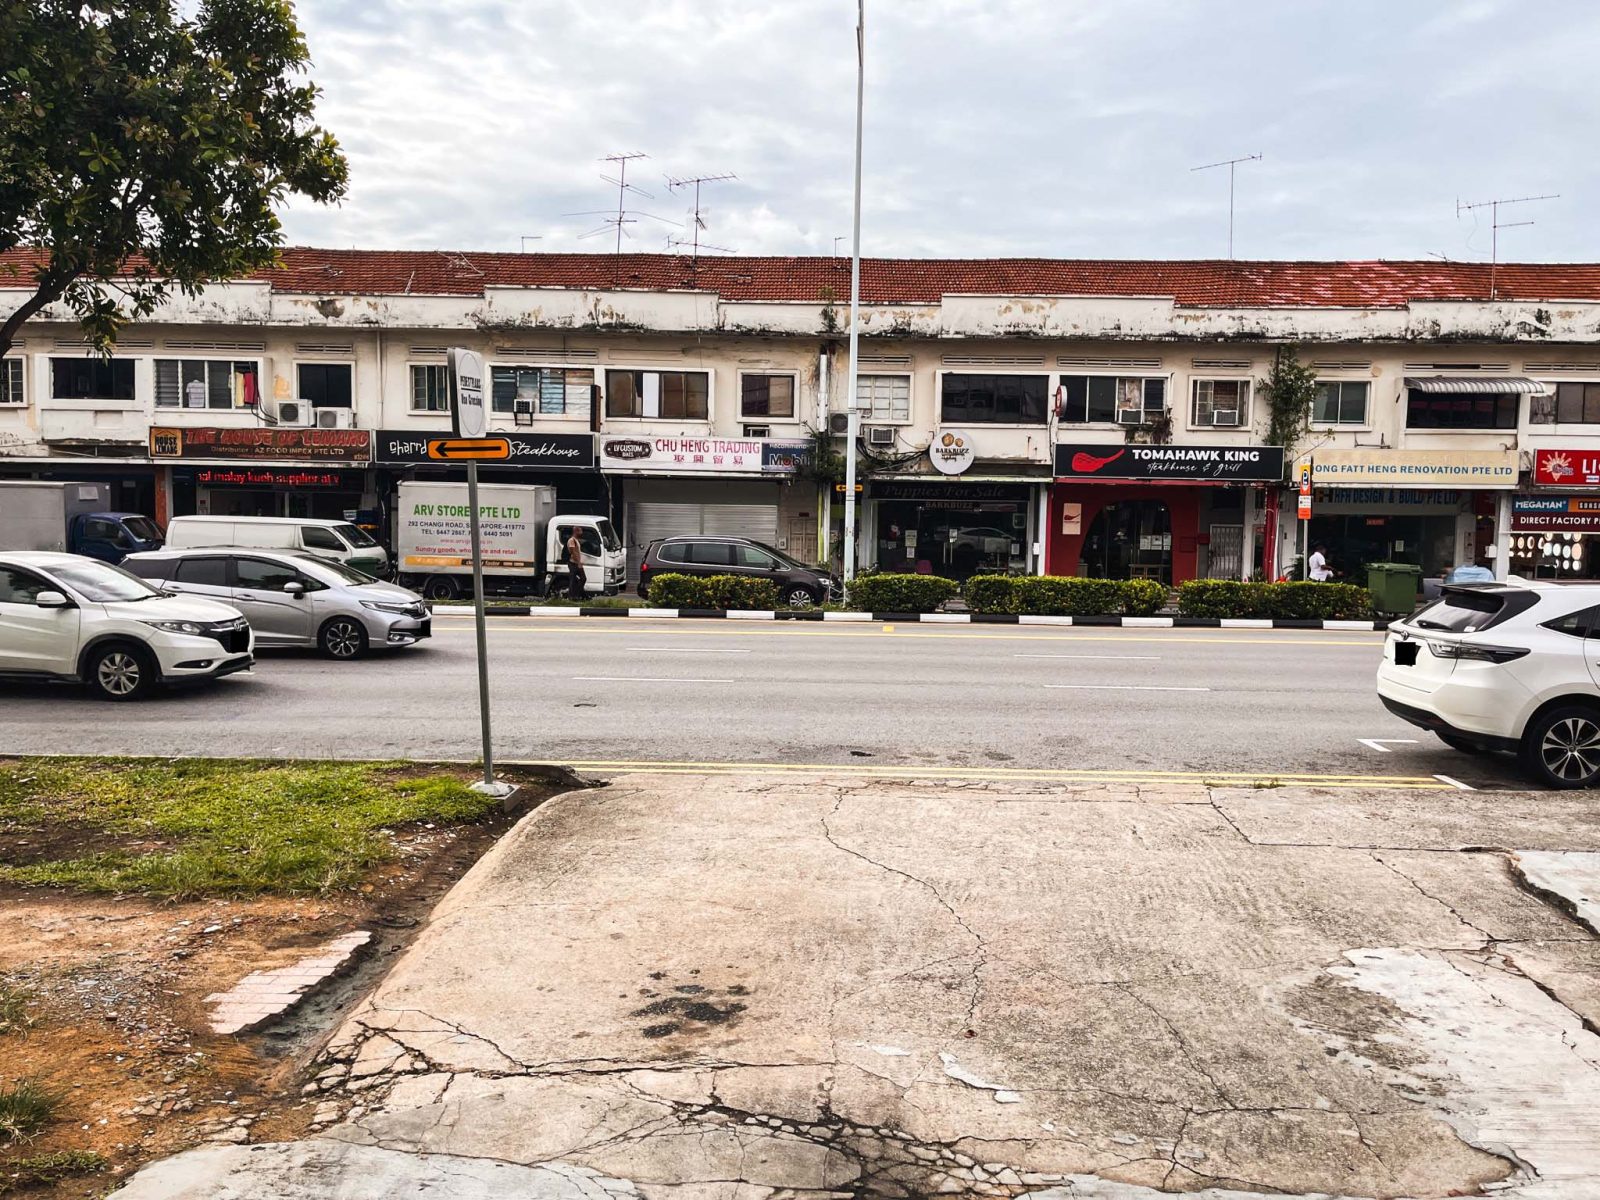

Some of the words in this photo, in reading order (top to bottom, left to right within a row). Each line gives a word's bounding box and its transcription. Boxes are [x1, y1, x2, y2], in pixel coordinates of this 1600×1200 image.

[186, 430, 216, 444] THE
[220, 430, 273, 446] HOUSE
[277, 431, 299, 446] OF
[511, 441, 581, 456] Steakhouse
[655, 439, 677, 452] CHU
[681, 440, 709, 453] HENG
[713, 440, 760, 454] TRADING
[1132, 449, 1220, 461] TOMAHAWK
[1224, 451, 1260, 462] KING
[1147, 461, 1197, 474] steakhouse
[1341, 465, 1364, 473] FATT
[1367, 465, 1397, 473] HENG
[1400, 466, 1469, 475] RENOVATION
[1494, 467, 1513, 475] LTD
[1582, 459, 1600, 474] LI
[413, 504, 434, 516] ARV
[480, 507, 498, 518] PTE
[501, 507, 521, 519] LTD
[1552, 517, 1592, 525] FACTORY
